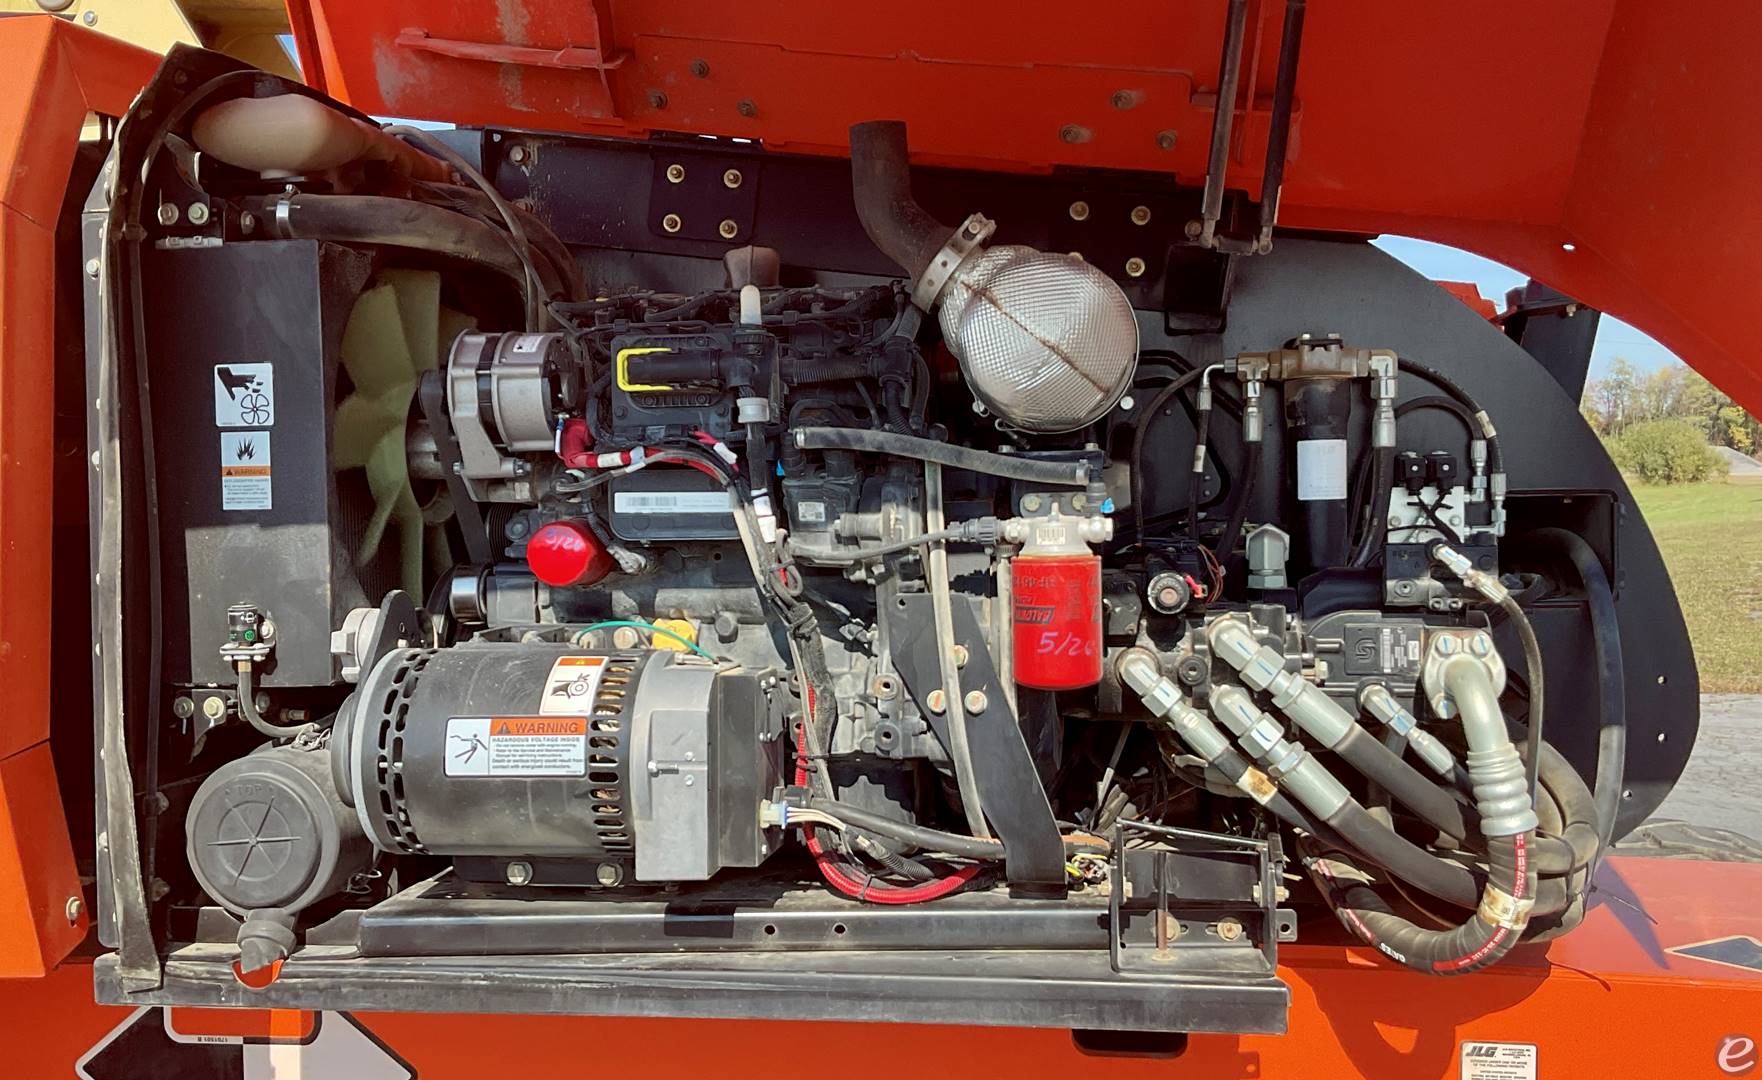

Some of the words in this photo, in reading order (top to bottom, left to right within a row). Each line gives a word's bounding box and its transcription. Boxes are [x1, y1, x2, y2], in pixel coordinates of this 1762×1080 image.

[515, 722, 579, 733] WARNING
[234, 783, 264, 797] TOP
[1465, 1045, 1499, 1058] JLG
